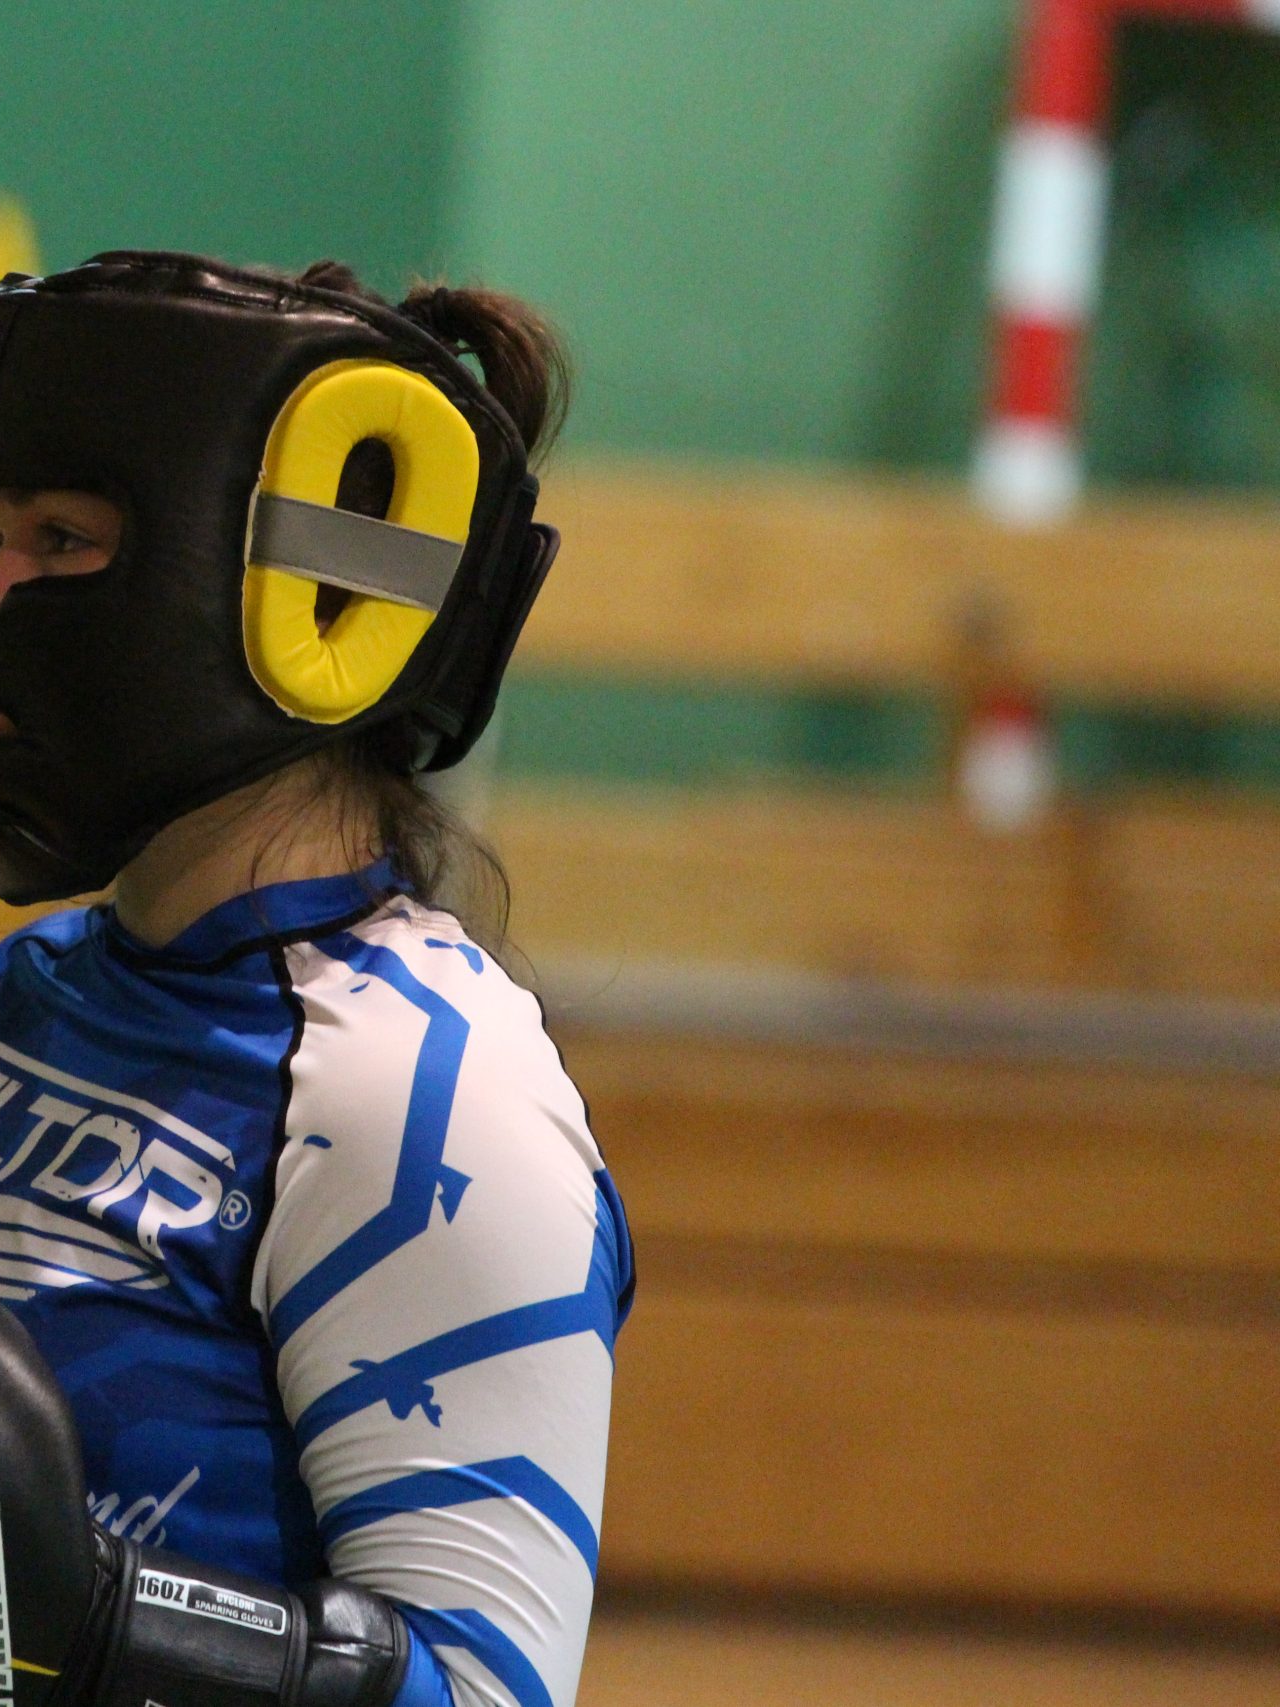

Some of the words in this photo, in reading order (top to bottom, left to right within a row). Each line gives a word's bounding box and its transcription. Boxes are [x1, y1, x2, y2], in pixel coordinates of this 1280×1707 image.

[194, 1600, 239, 1619] SPARRING
[240, 1612, 274, 1629] GLOVES
[216, 1592, 257, 1613] CYCLONE
